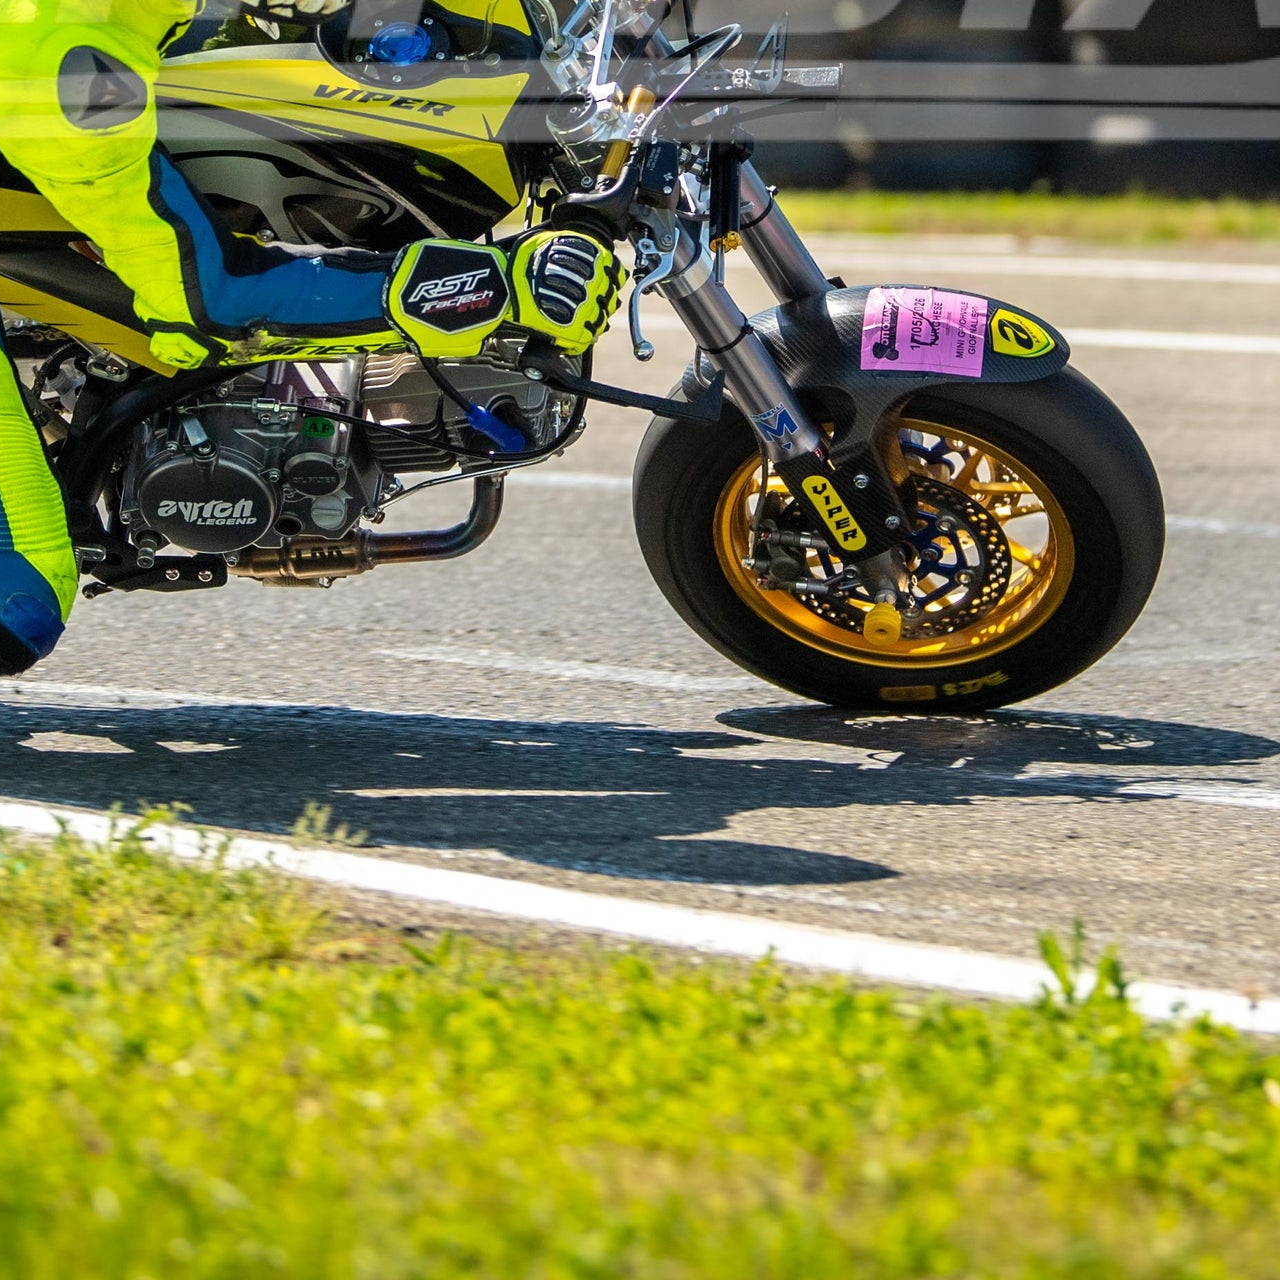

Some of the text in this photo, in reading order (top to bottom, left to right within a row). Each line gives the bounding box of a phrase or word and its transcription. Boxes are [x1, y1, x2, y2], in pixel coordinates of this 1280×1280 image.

[313, 83, 457, 117] VIPER
[408, 268, 491, 303] RST
[881, 297, 892, 346] OTTOBIAN
[955, 339, 965, 359] MINI
[197, 517, 257, 526] LEGEND
[811, 482, 858, 543] VIPER
